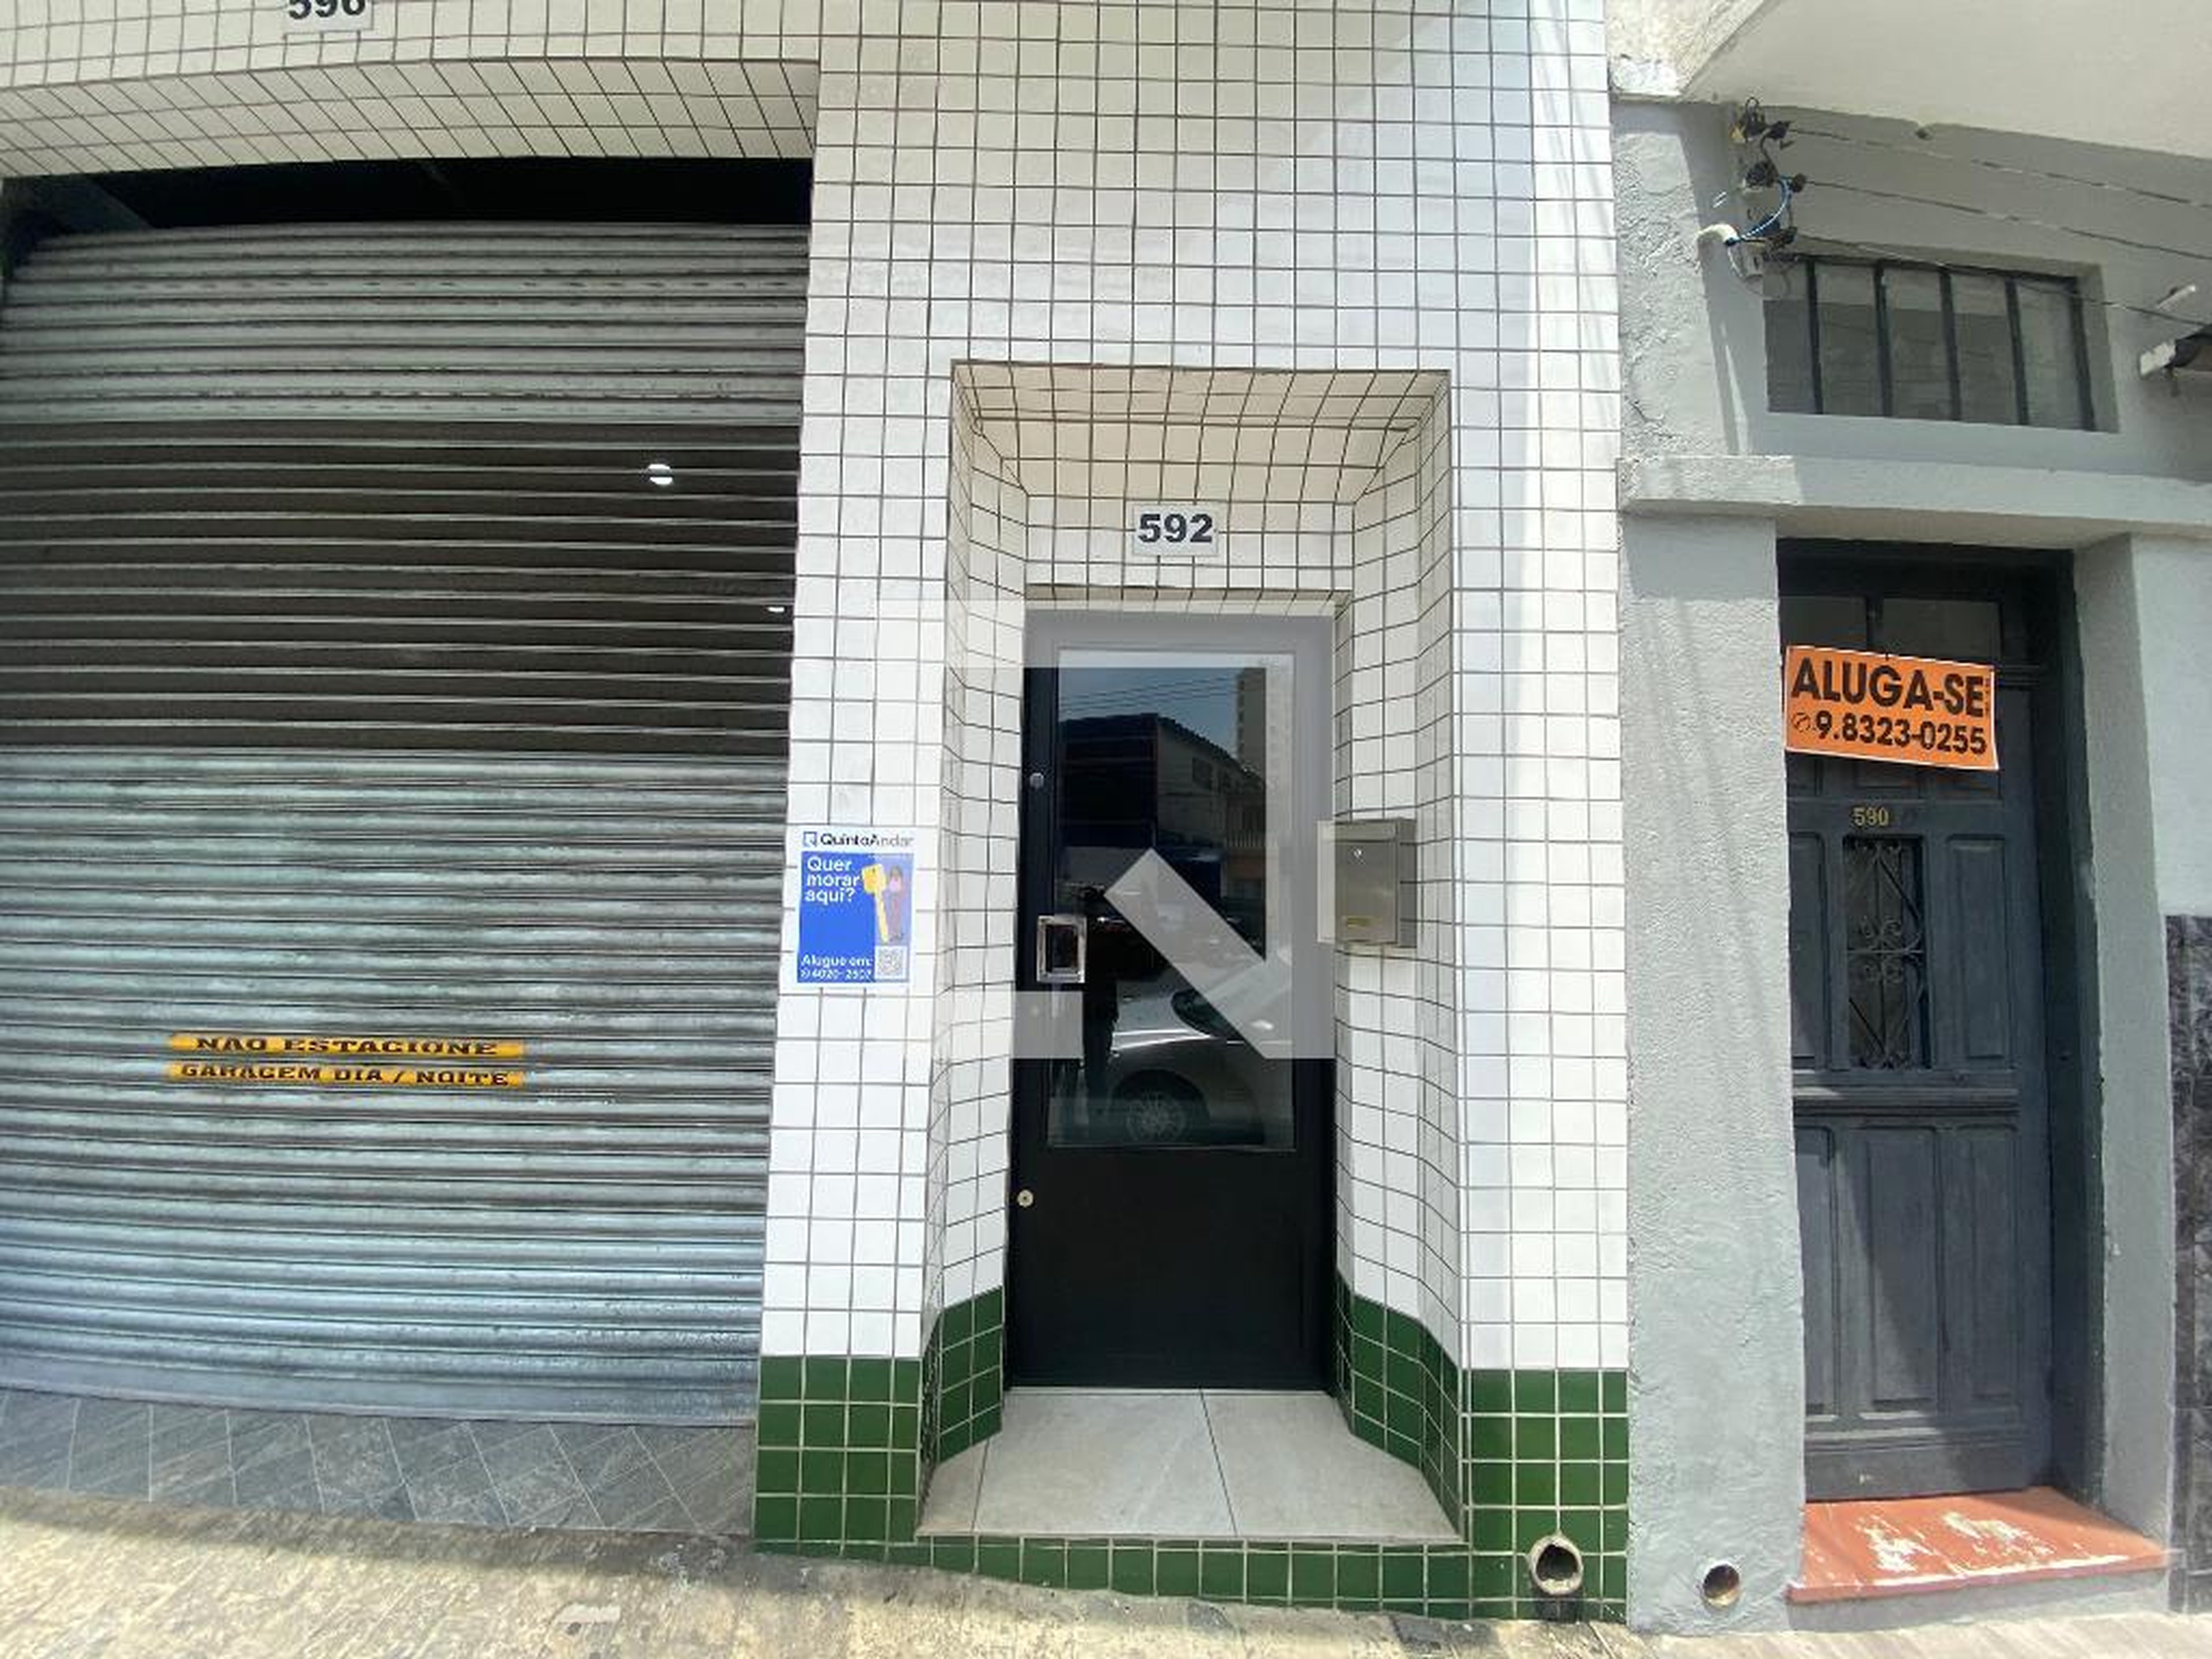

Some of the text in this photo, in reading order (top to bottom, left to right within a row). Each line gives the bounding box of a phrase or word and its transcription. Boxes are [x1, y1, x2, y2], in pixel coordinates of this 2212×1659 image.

[1137, 514, 1213, 543] 592
[1791, 657, 1984, 718] ALUGA-SE
[1816, 710, 1986, 754] 9.8323-0255
[1854, 807, 1889, 826] 590
[820, 833, 915, 846] QuintoAndar
[807, 857, 853, 872] Quer
[807, 874, 860, 887] morar
[805, 887, 856, 905] aqui?
[801, 954, 847, 968] Alugue
[284, 1039, 497, 1055] ESTACIONE
[181, 1064, 320, 1080] GARAGEM
[334, 1069, 382, 1082] DIA
[416, 1070, 509, 1086] NOITE
